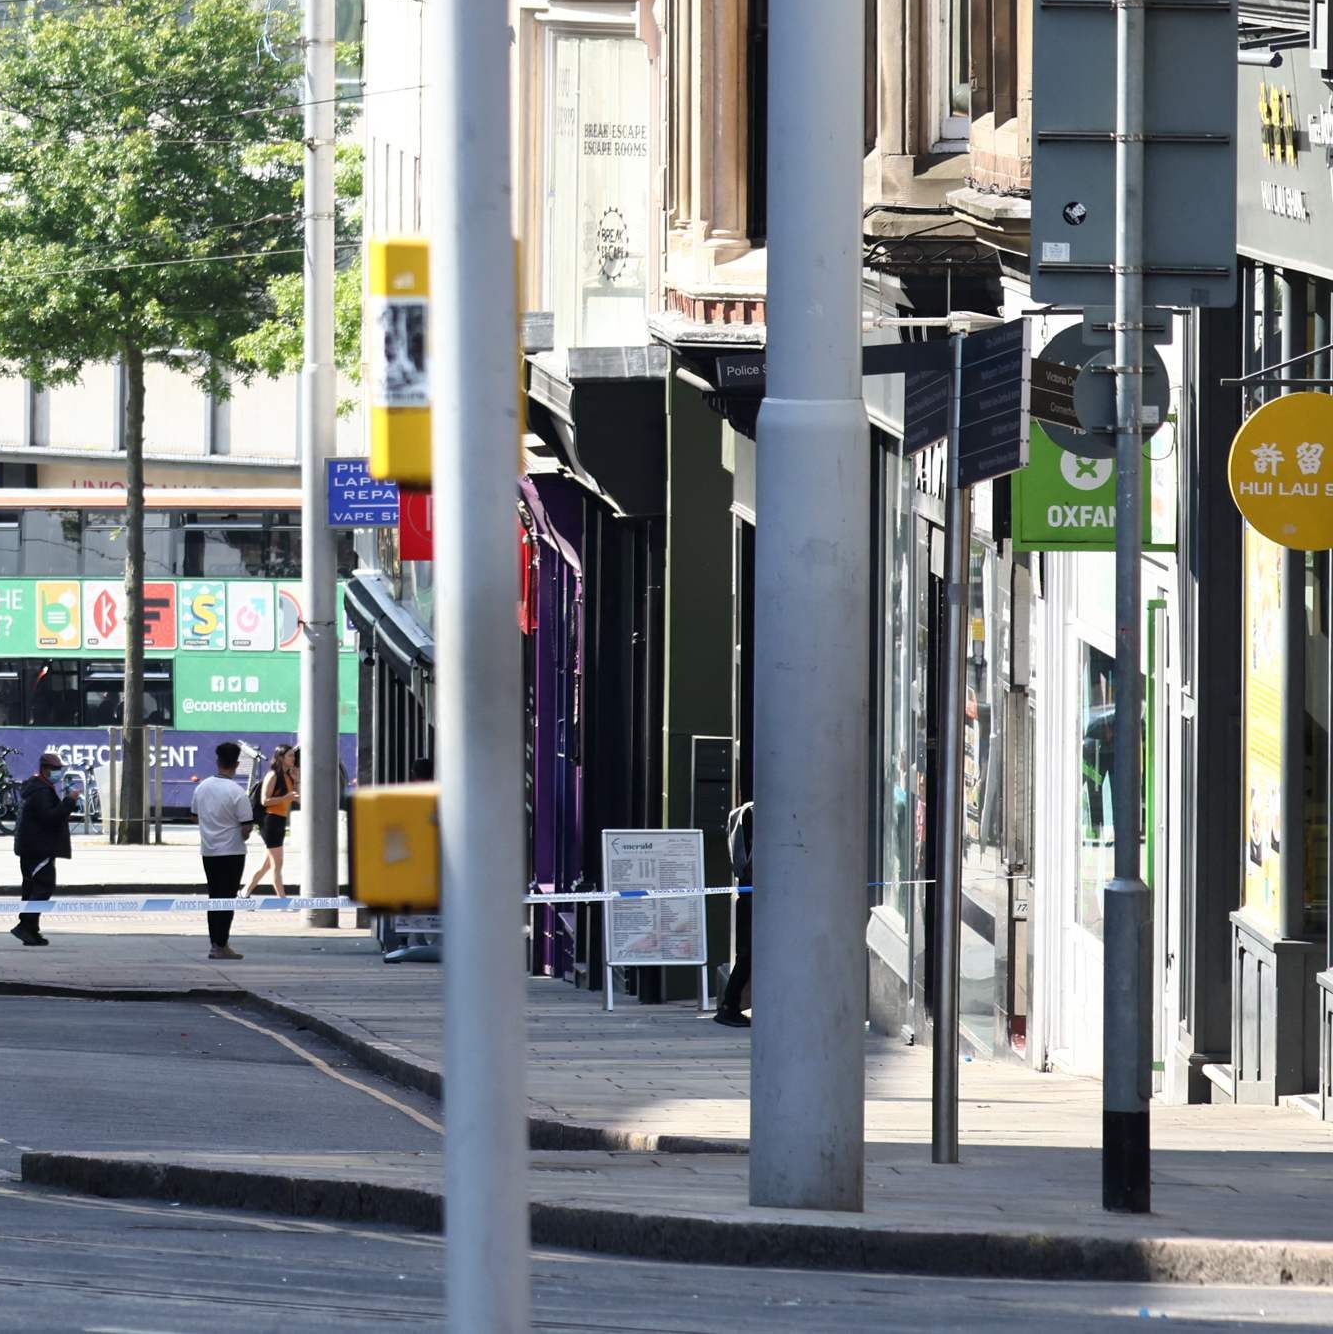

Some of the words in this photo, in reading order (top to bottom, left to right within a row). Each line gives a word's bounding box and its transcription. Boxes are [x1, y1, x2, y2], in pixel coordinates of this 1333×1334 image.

[611, 124, 647, 139] ESCAPE
[614, 141, 647, 157] ROOMS
[1239, 482, 1272, 495] HUI
[1279, 482, 1318, 496] LAU
[334, 512, 374, 521] VAPE
[182, 698, 287, 714] @consentinnotts
